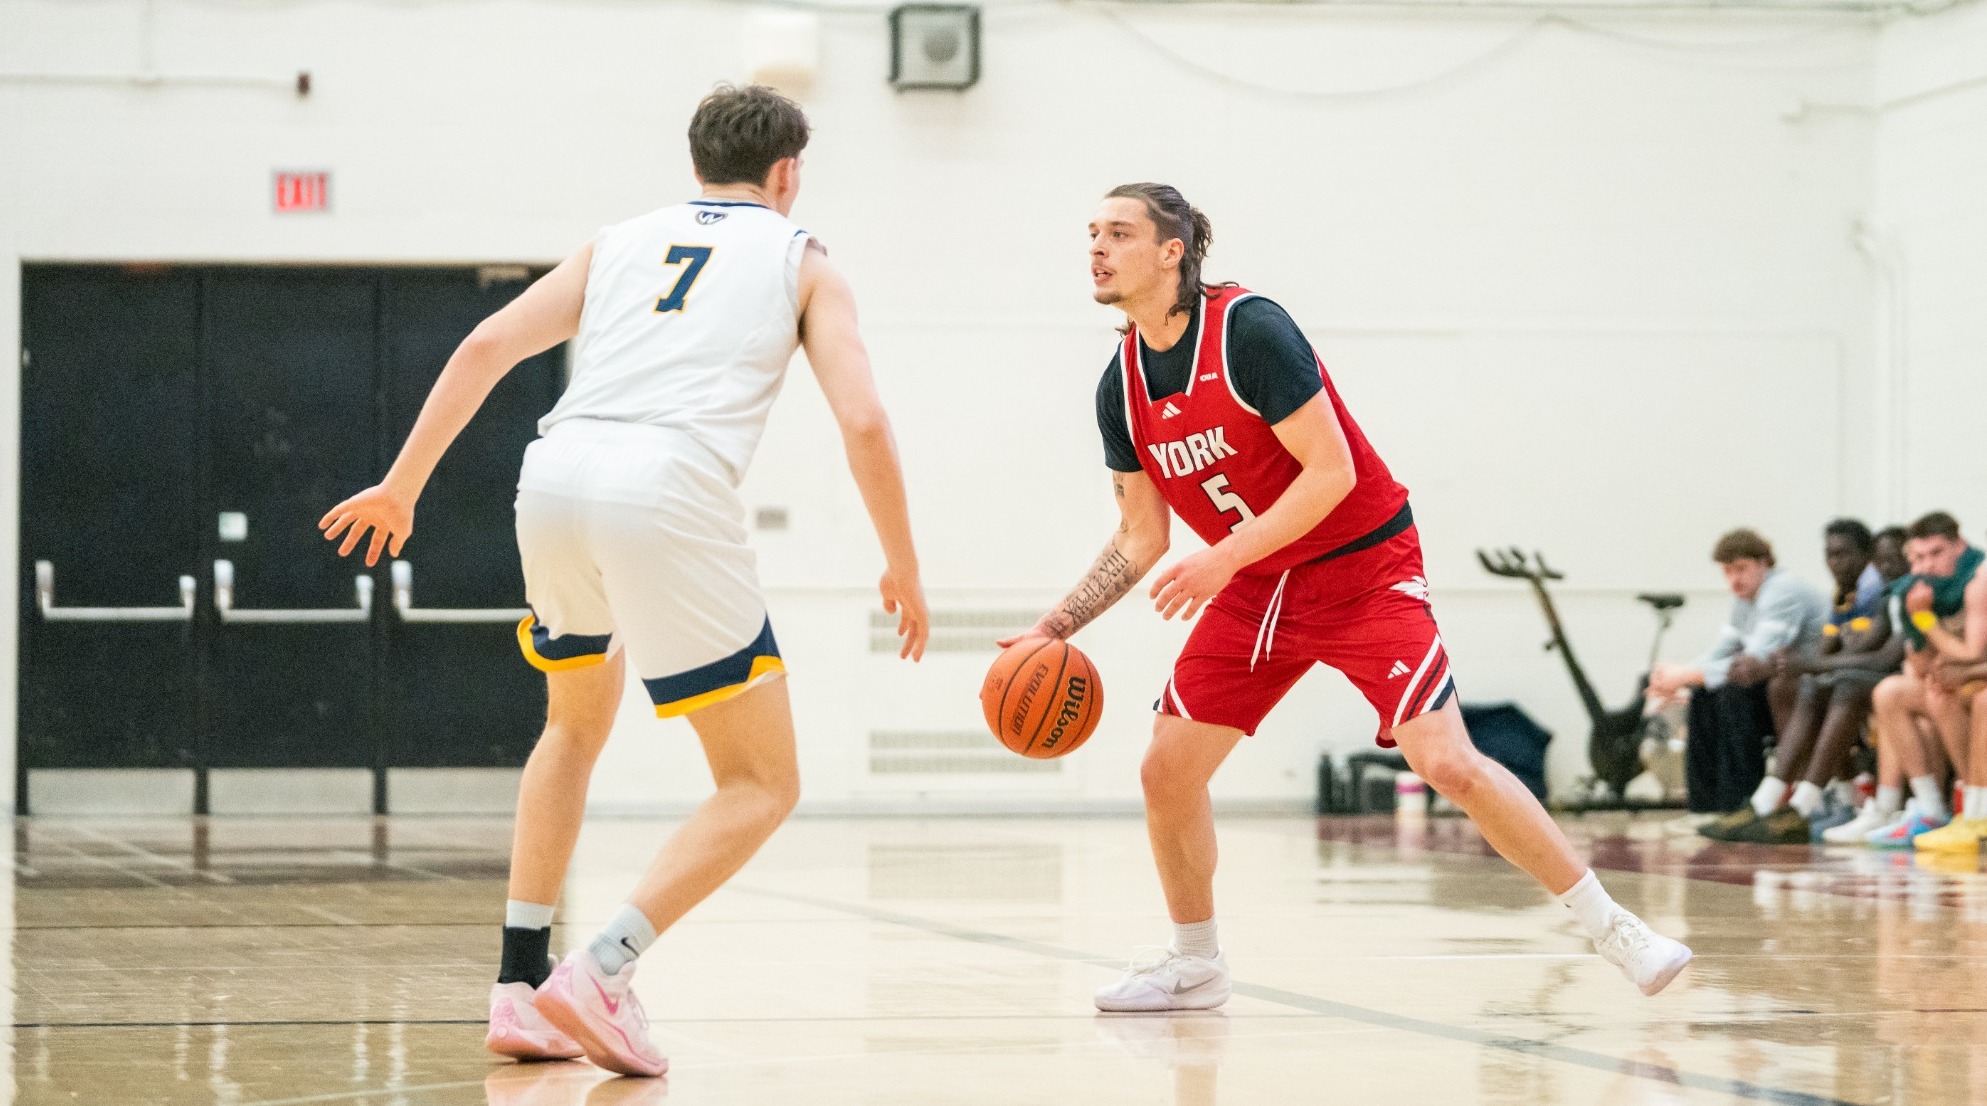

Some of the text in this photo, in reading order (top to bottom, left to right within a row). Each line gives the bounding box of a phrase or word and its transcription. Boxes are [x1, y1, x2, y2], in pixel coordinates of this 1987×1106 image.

[276, 174, 327, 211] EXIT
[652, 243, 716, 314] 7
[1147, 425, 1239, 480] YORK
[1199, 472, 1258, 534] 5
[1010, 663, 1049, 736] EVOLUTION
[1041, 676, 1086, 750] Wilson
